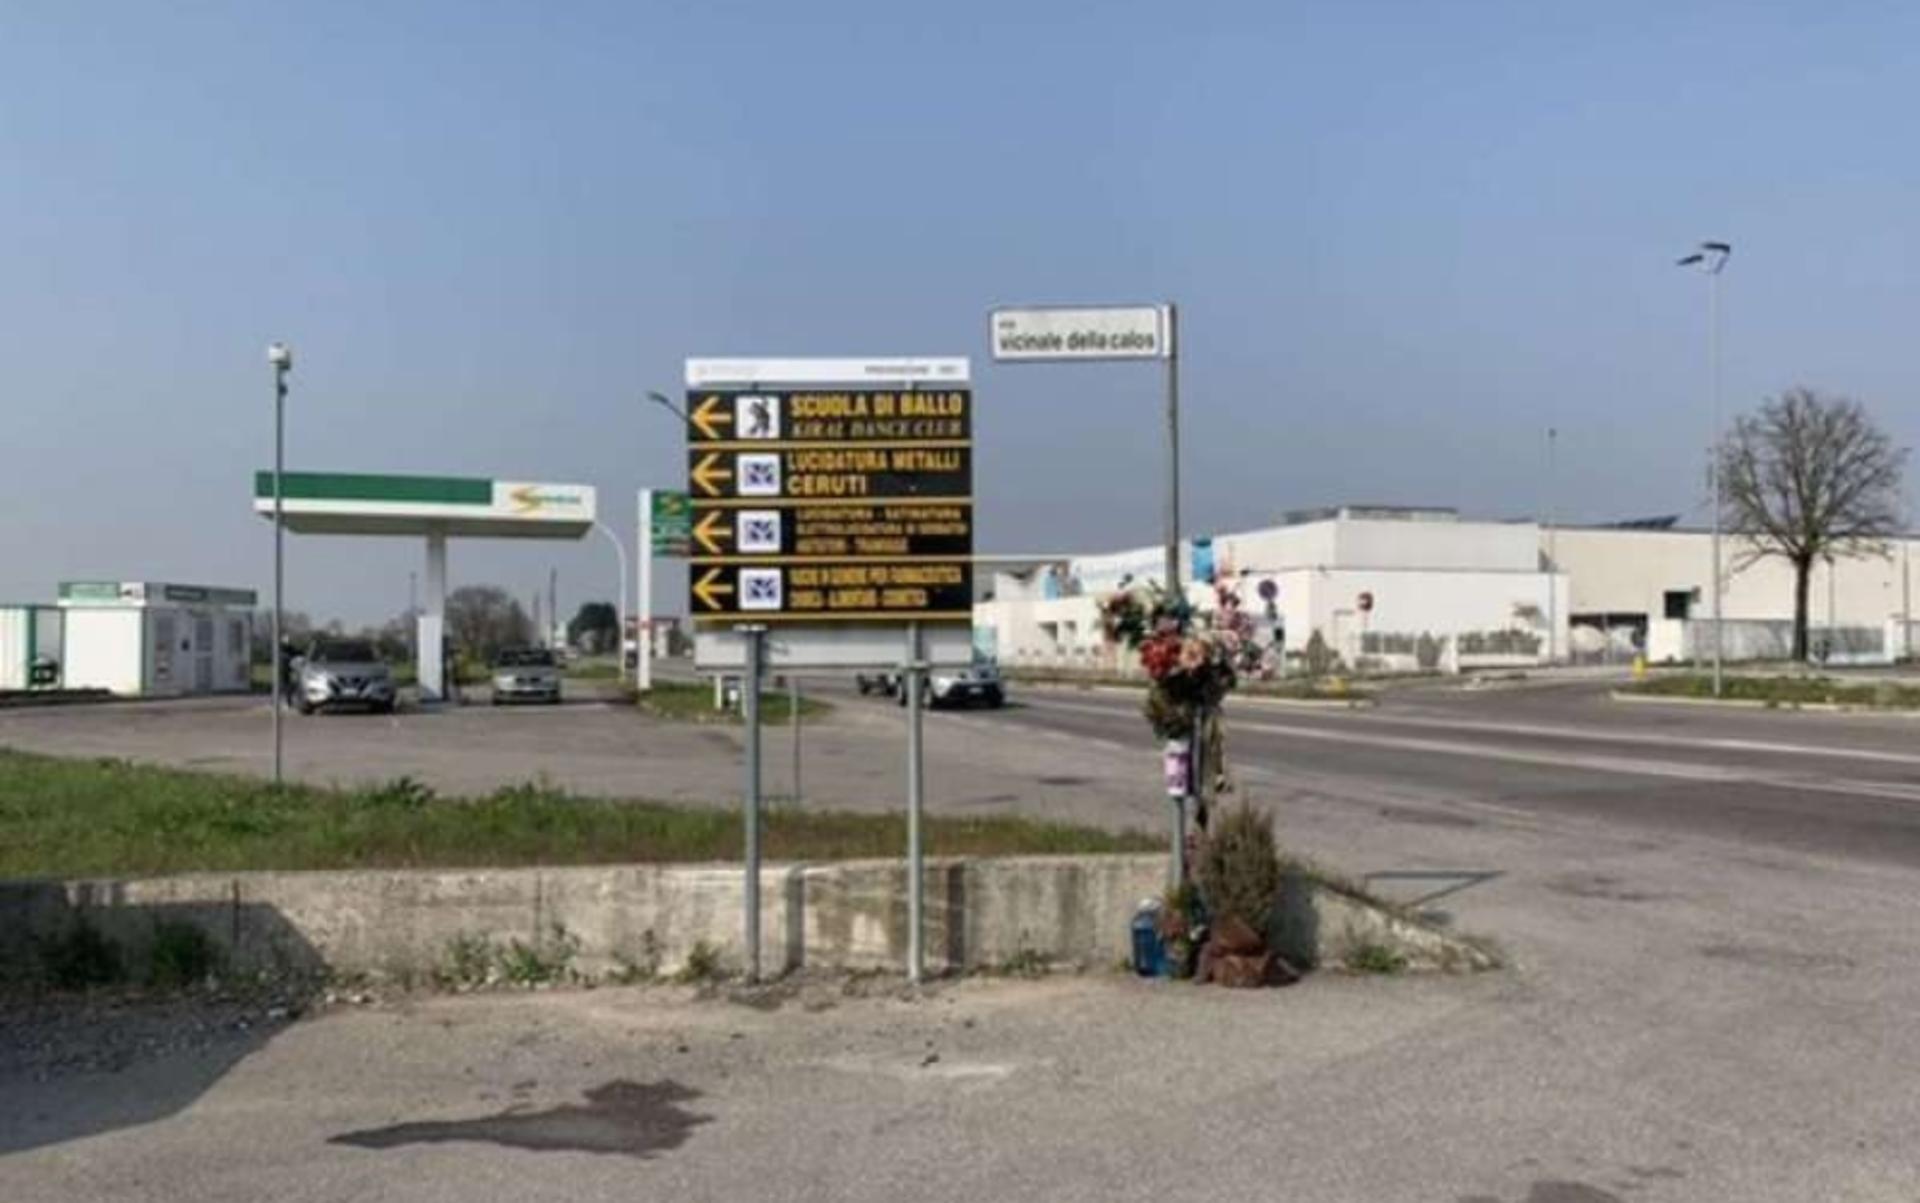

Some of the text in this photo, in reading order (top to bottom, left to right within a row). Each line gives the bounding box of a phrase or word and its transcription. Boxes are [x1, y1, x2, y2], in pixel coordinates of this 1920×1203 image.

[1001, 332, 1063, 351] vicinale
[1067, 330, 1107, 350] della
[790, 392, 962, 417] SCUOLA DI BALLO
[787, 449, 960, 472] LUCIDATURA METALLI
[787, 475, 867, 495] CERUTI
